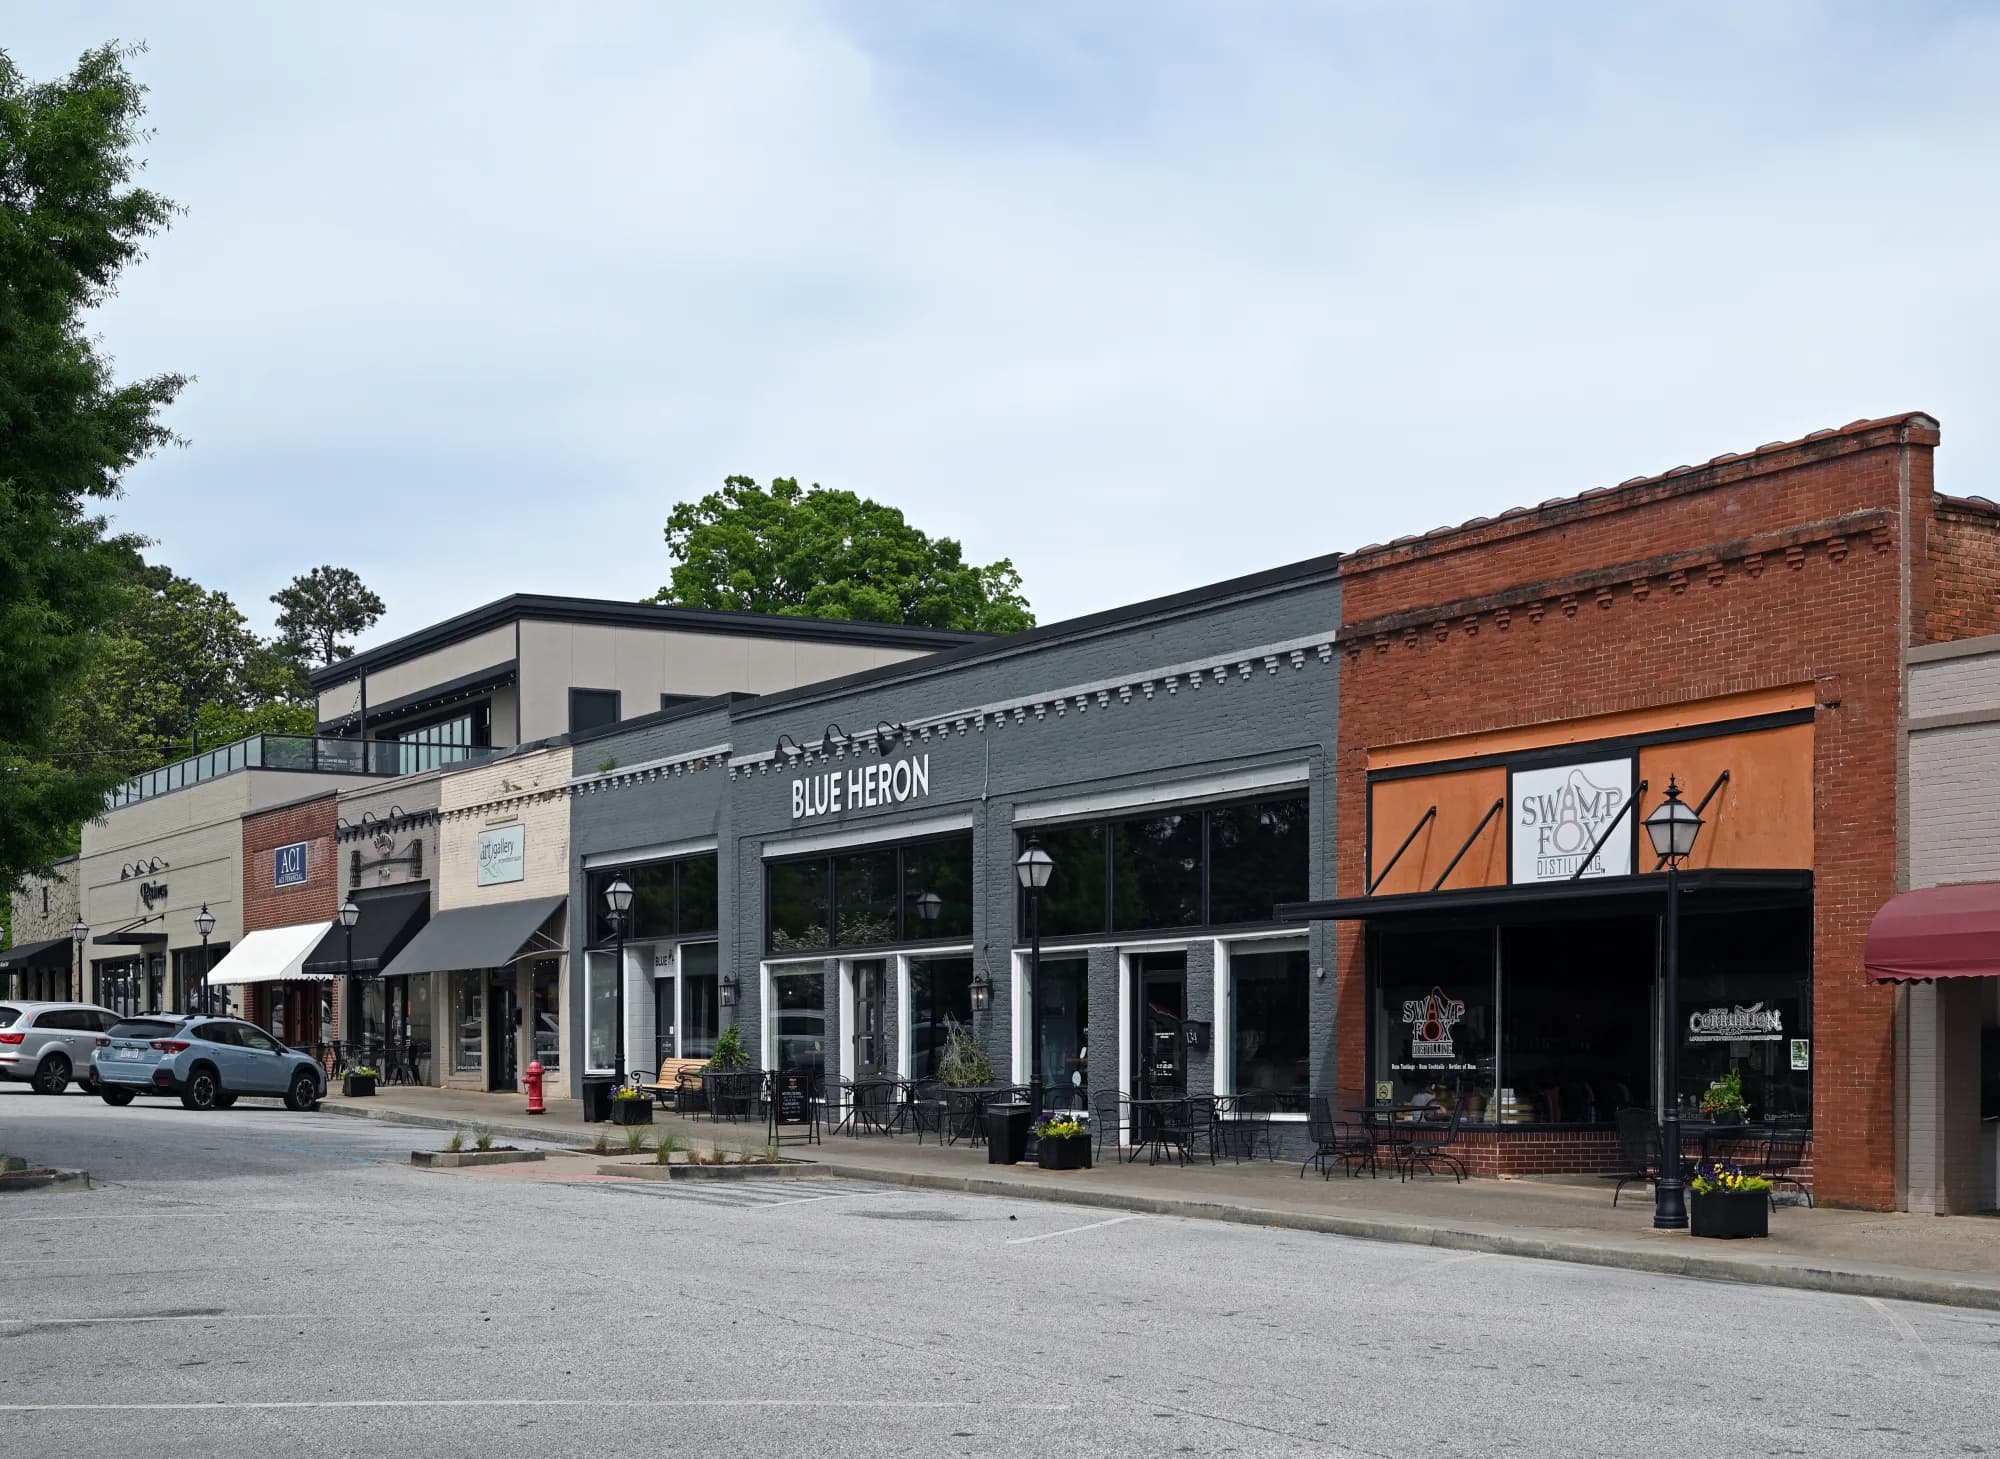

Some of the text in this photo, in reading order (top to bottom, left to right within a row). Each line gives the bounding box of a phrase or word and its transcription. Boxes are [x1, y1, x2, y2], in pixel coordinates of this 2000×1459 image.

[792, 754, 929, 819] BLUE HERON
[1521, 782, 1623, 826] SWAMP
[493, 837, 514, 859] gallery
[1538, 820, 1602, 855] FOX
[281, 847, 300, 874] ACI
[655, 954, 668, 967] BLUE
[1403, 995, 1465, 1023] SWAMP
[1412, 1018, 1454, 1043] FOX
[1412, 1042, 1455, 1056] DISTILLING
